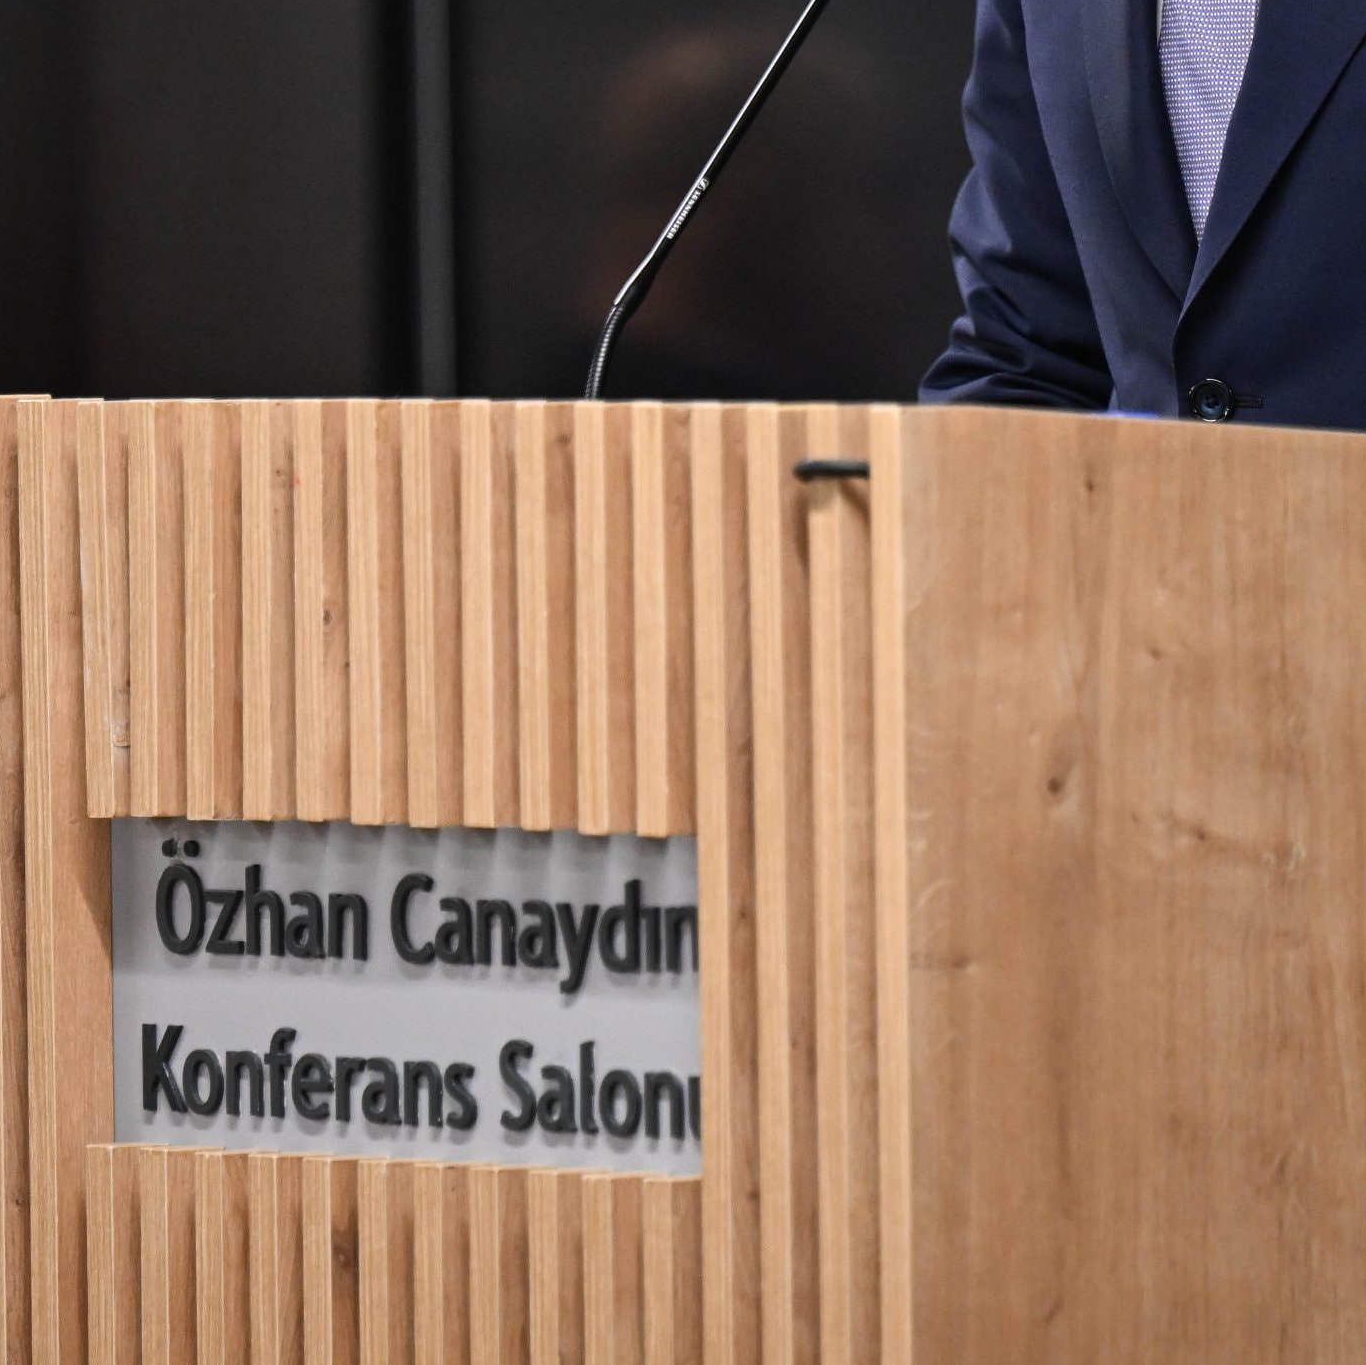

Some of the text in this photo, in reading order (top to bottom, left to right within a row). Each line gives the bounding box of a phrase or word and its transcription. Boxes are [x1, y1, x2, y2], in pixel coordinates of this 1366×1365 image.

[666, 190, 701, 240] SENNHEISER
[155, 839, 699, 995] Özhan Canaydın
[141, 1023, 477, 1131] Konferans
